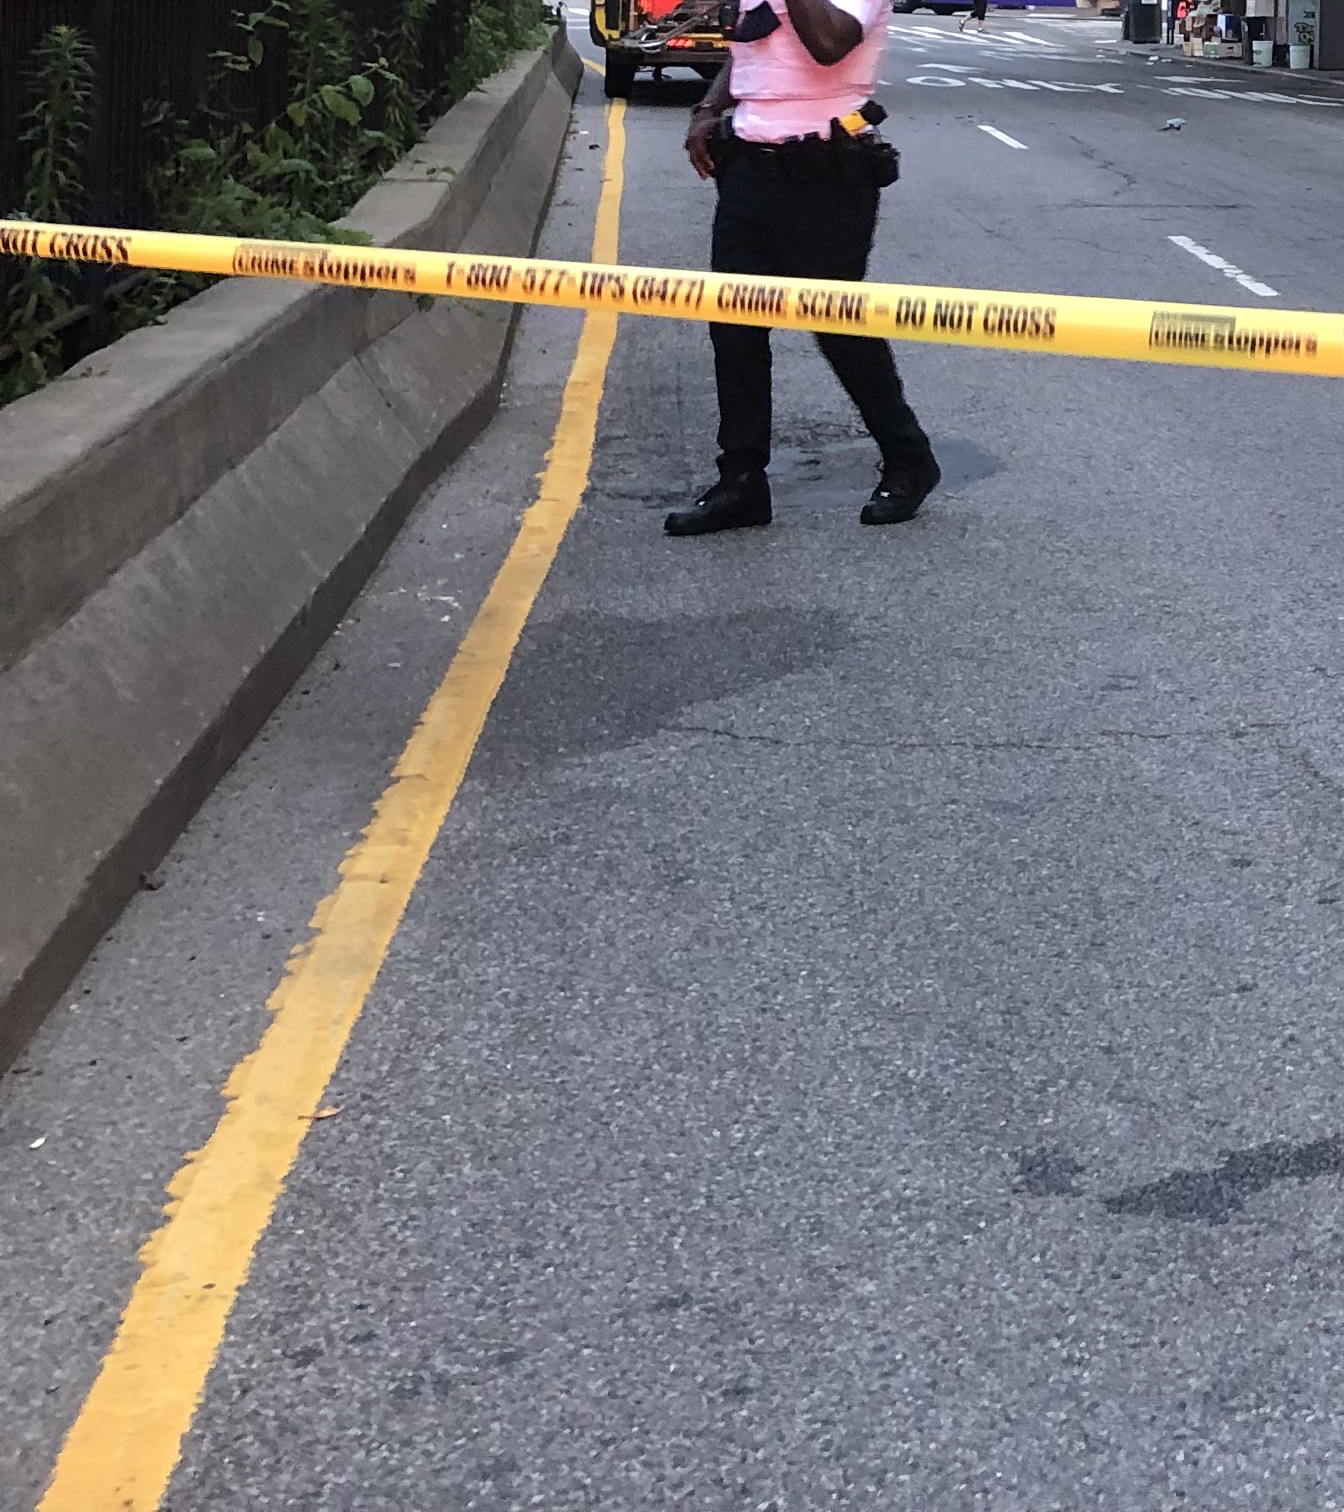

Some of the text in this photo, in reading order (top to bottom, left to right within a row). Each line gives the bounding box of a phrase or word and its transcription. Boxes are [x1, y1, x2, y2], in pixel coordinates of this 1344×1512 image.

[895, 296, 927, 330] DO
[933, 297, 978, 335] NOT
[983, 301, 1056, 341] CROSS
